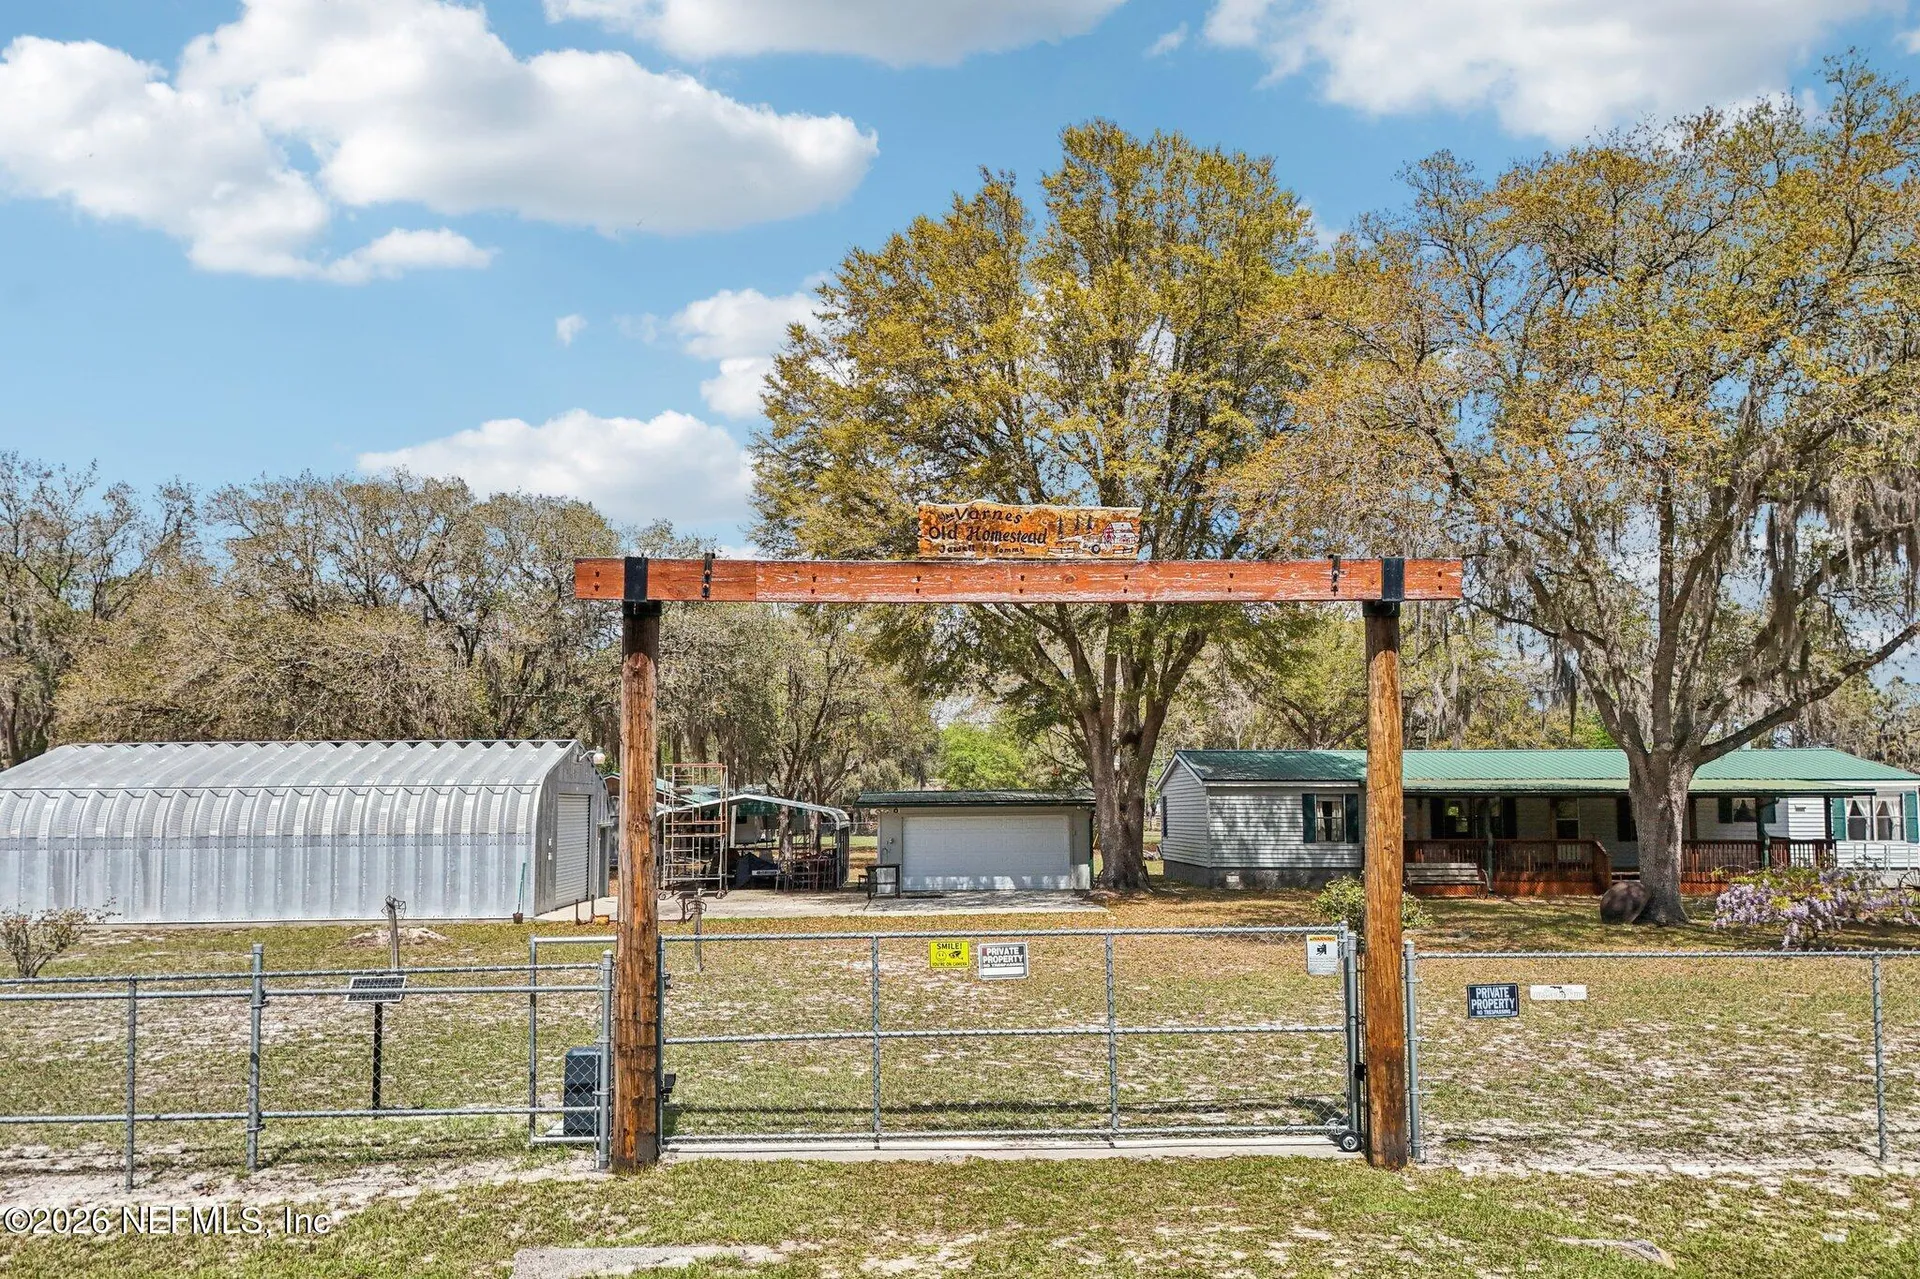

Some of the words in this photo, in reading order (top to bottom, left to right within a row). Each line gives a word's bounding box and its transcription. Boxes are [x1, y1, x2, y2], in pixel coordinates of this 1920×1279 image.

[955, 507, 1022, 524] Varnes
[928, 525, 957, 540] Old
[966, 525, 1047, 545] Homestead
[986, 947, 1019, 956] PRIVATE
[983, 955, 1023, 963] PROPERTY
[1475, 987, 1509, 999] PRIVATE
[1471, 998, 1515, 1010] PROPERTY
